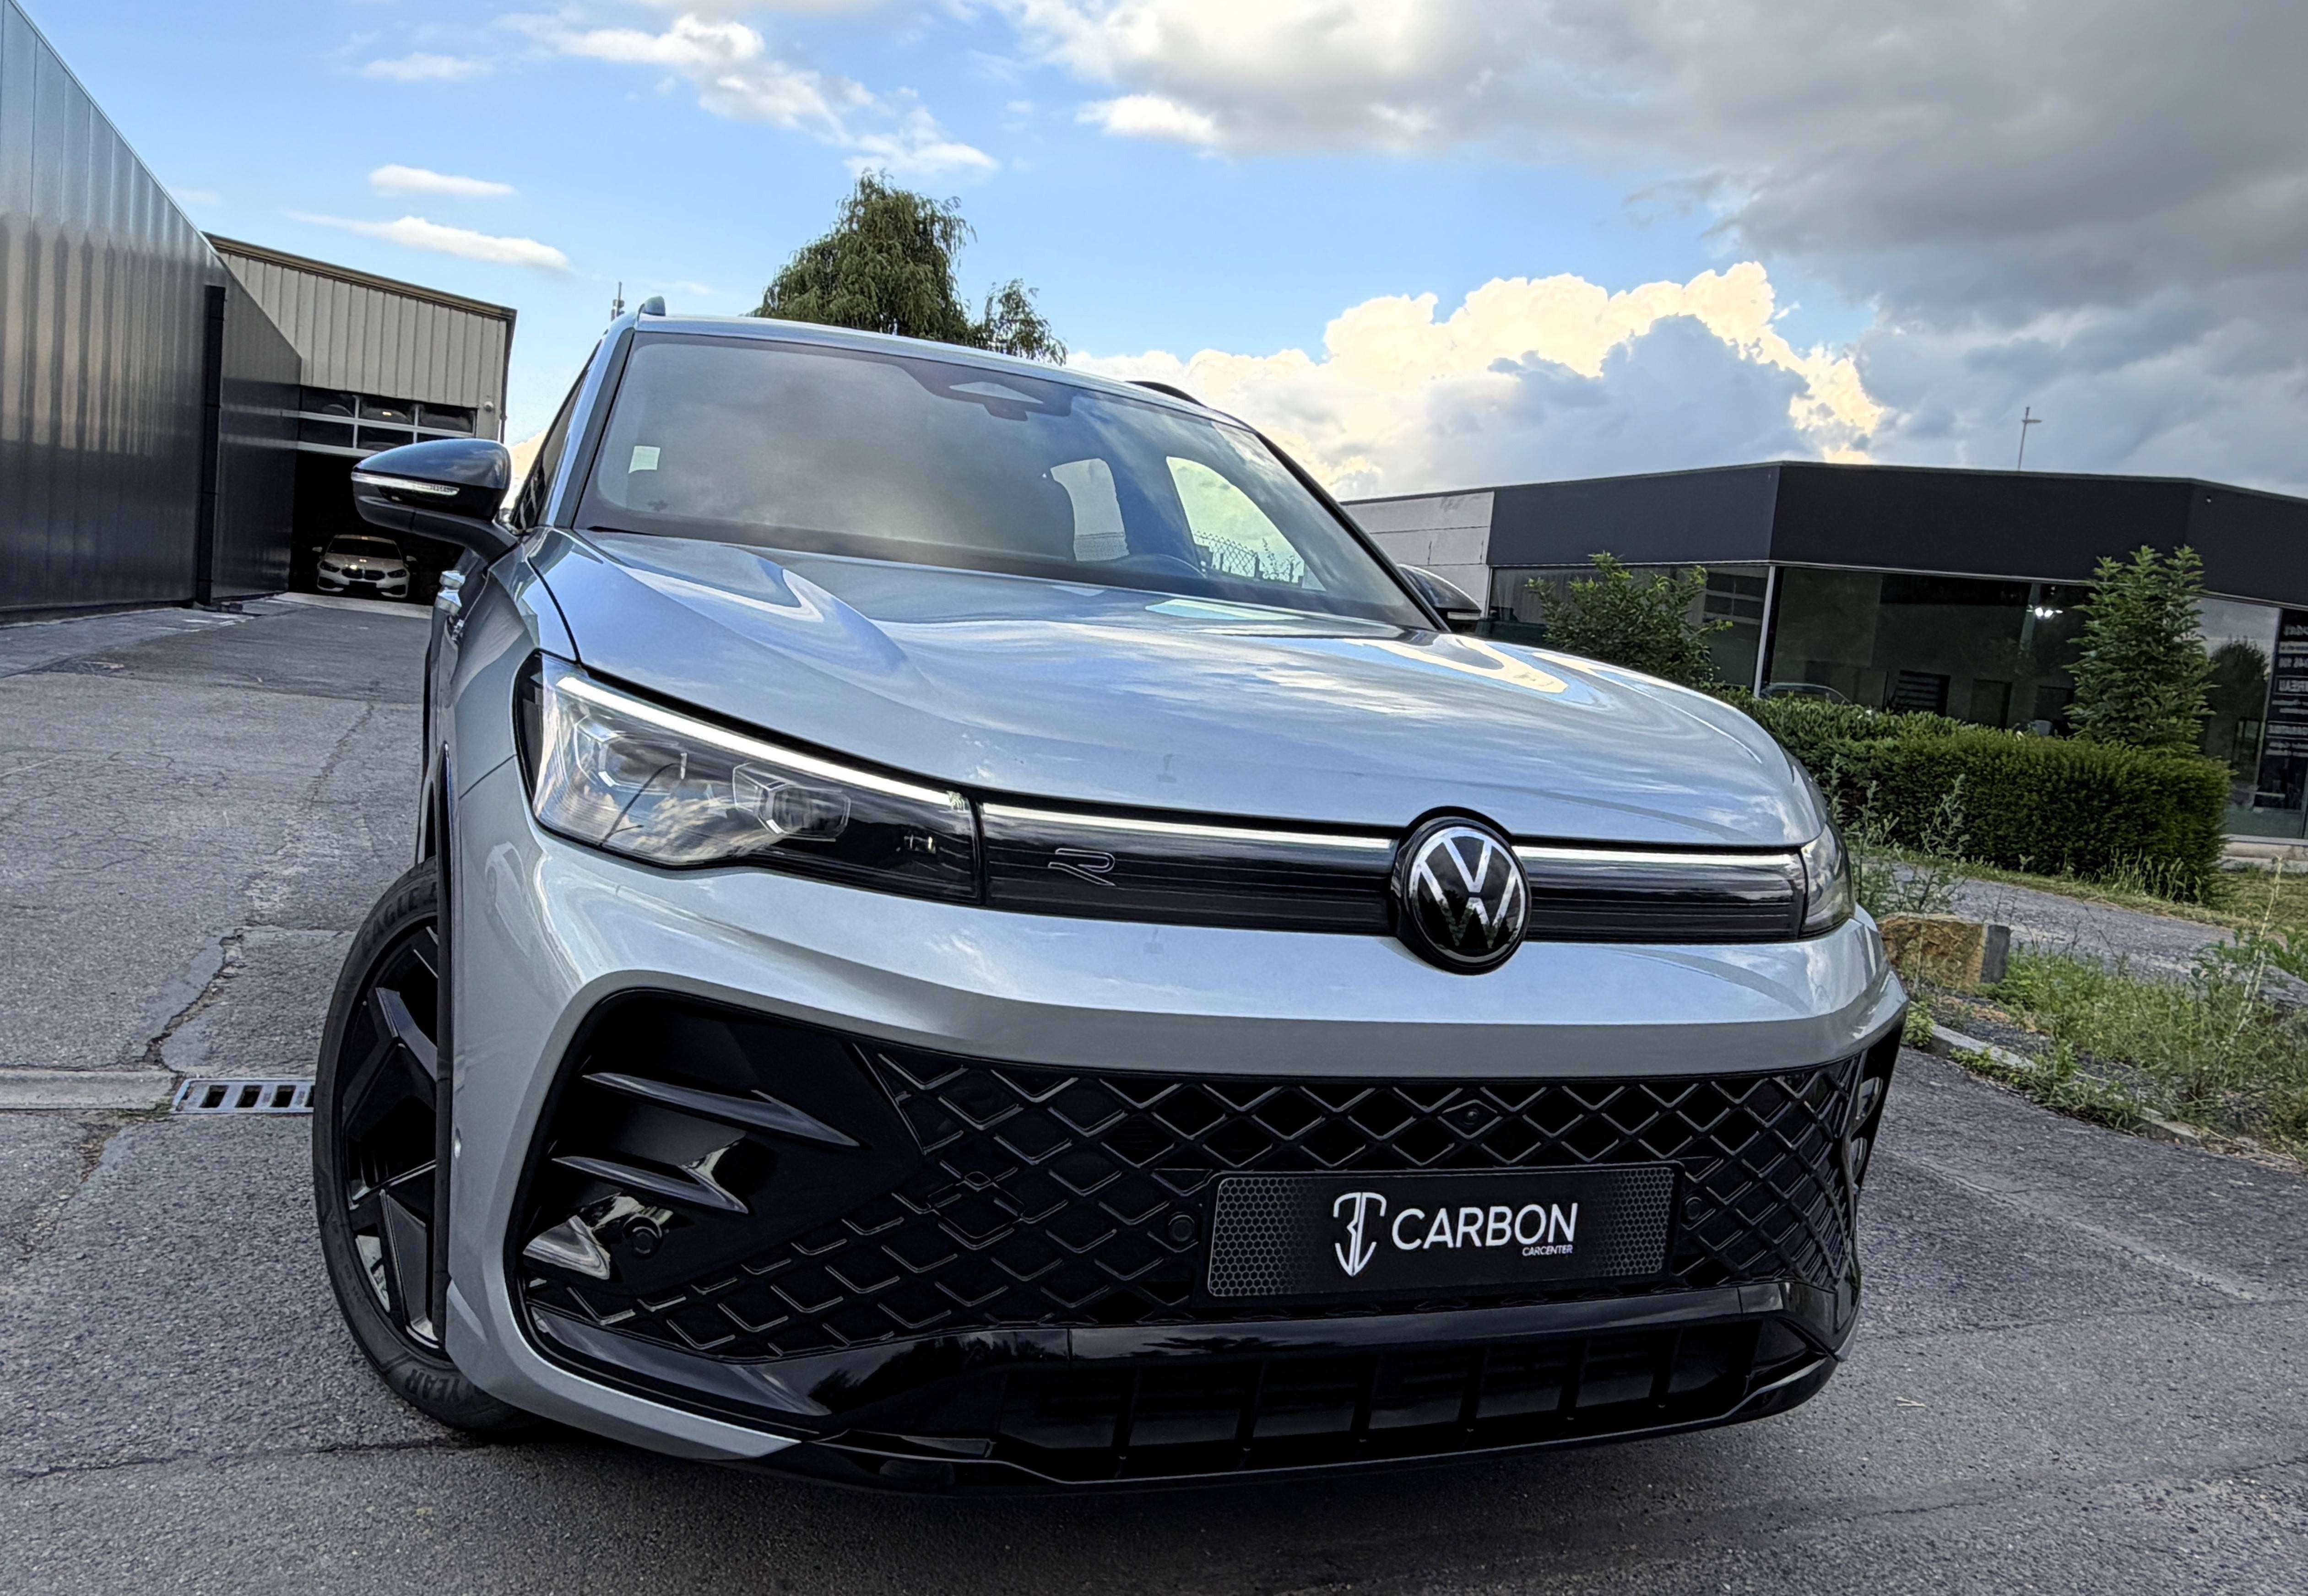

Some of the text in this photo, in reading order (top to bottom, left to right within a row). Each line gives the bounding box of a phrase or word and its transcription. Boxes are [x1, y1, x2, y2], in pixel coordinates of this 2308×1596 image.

[1048, 848, 1116, 886] R
[1392, 1203, 1578, 1250] CARBON
[1522, 1244, 1573, 1257] CARCENTER
[404, 1369, 467, 1406] YEAR
